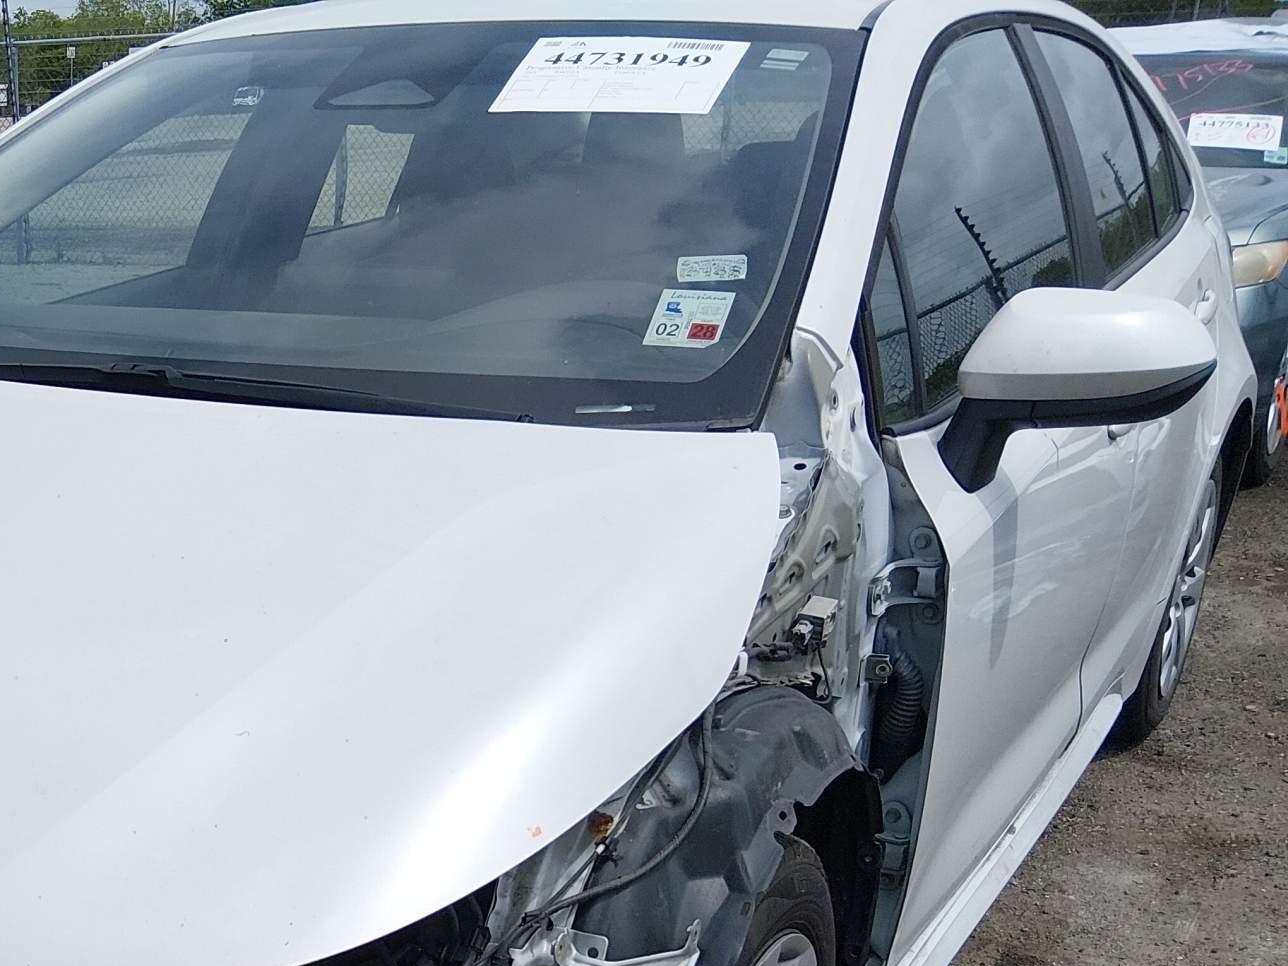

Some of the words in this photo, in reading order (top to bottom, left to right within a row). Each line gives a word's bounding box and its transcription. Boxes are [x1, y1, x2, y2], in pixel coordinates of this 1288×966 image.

[544, 51, 712, 67] 44731949
[670, 291, 729, 301] Louisiana
[655, 322, 680, 337] 02
[690, 324, 716, 340] 28
